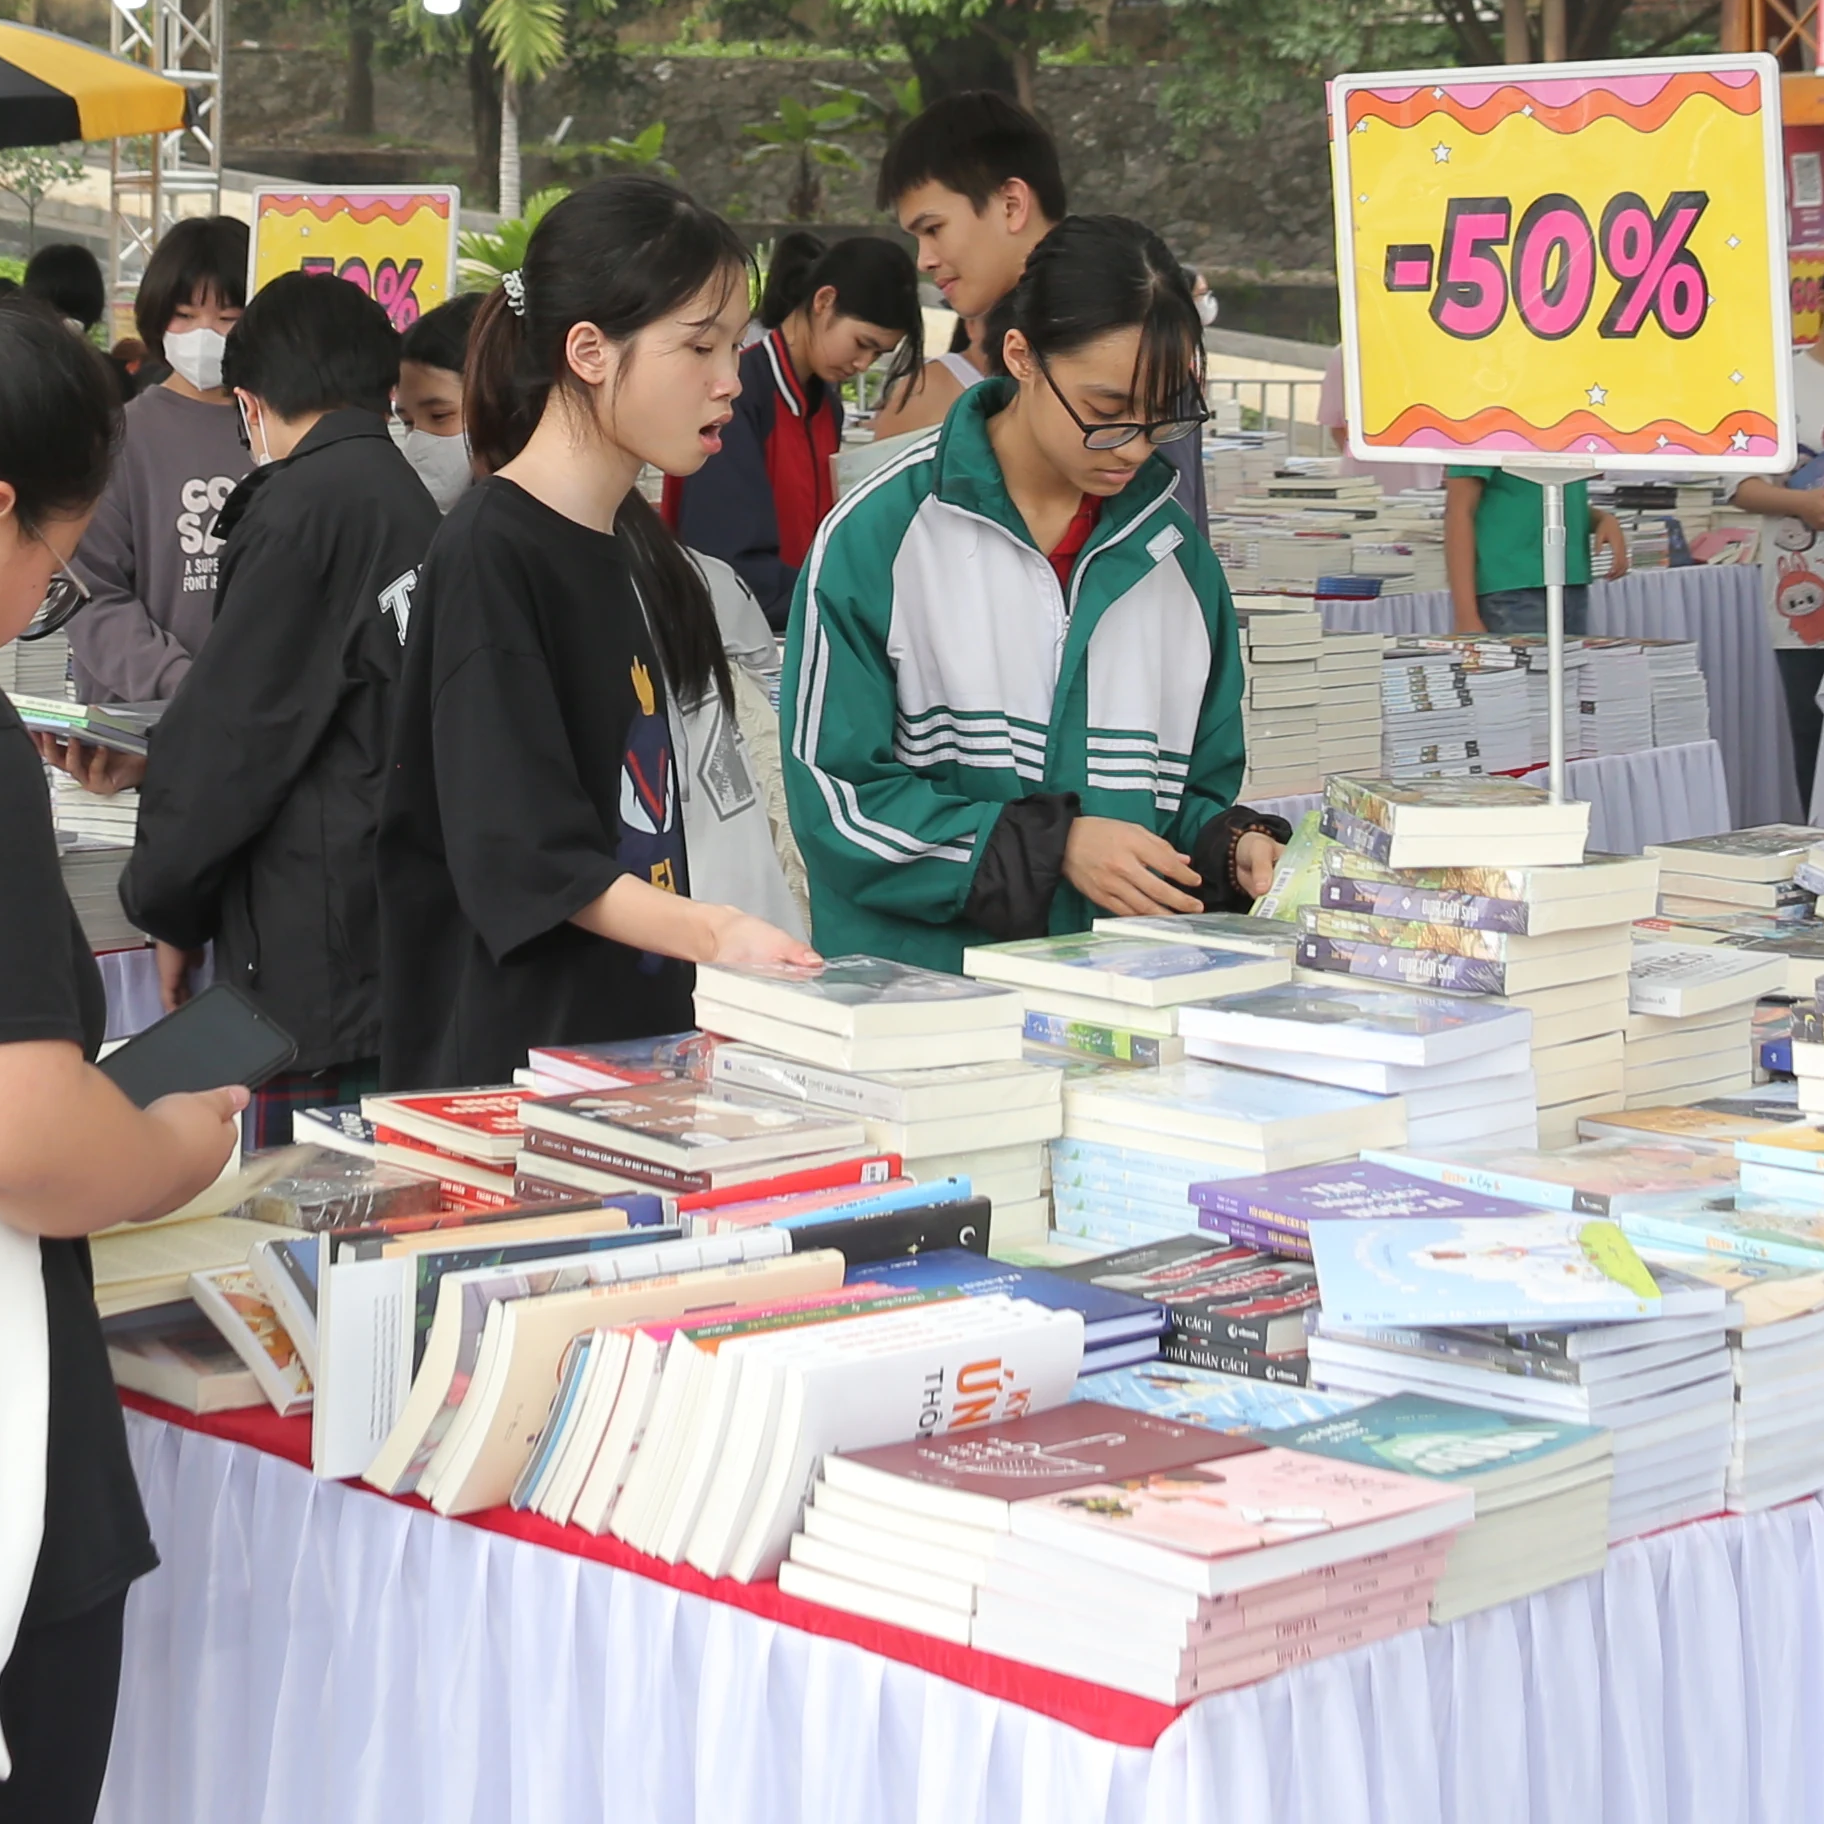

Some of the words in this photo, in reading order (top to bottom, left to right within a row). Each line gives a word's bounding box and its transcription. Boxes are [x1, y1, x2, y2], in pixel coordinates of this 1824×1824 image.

[1384, 190, 1711, 341] -50%
[184, 560, 193, 576] A
[1185, 1315, 1212, 1334] CÁCH
[1189, 1348, 1219, 1370] NHÂN
[1220, 1355, 1249, 1376] CÁCH
